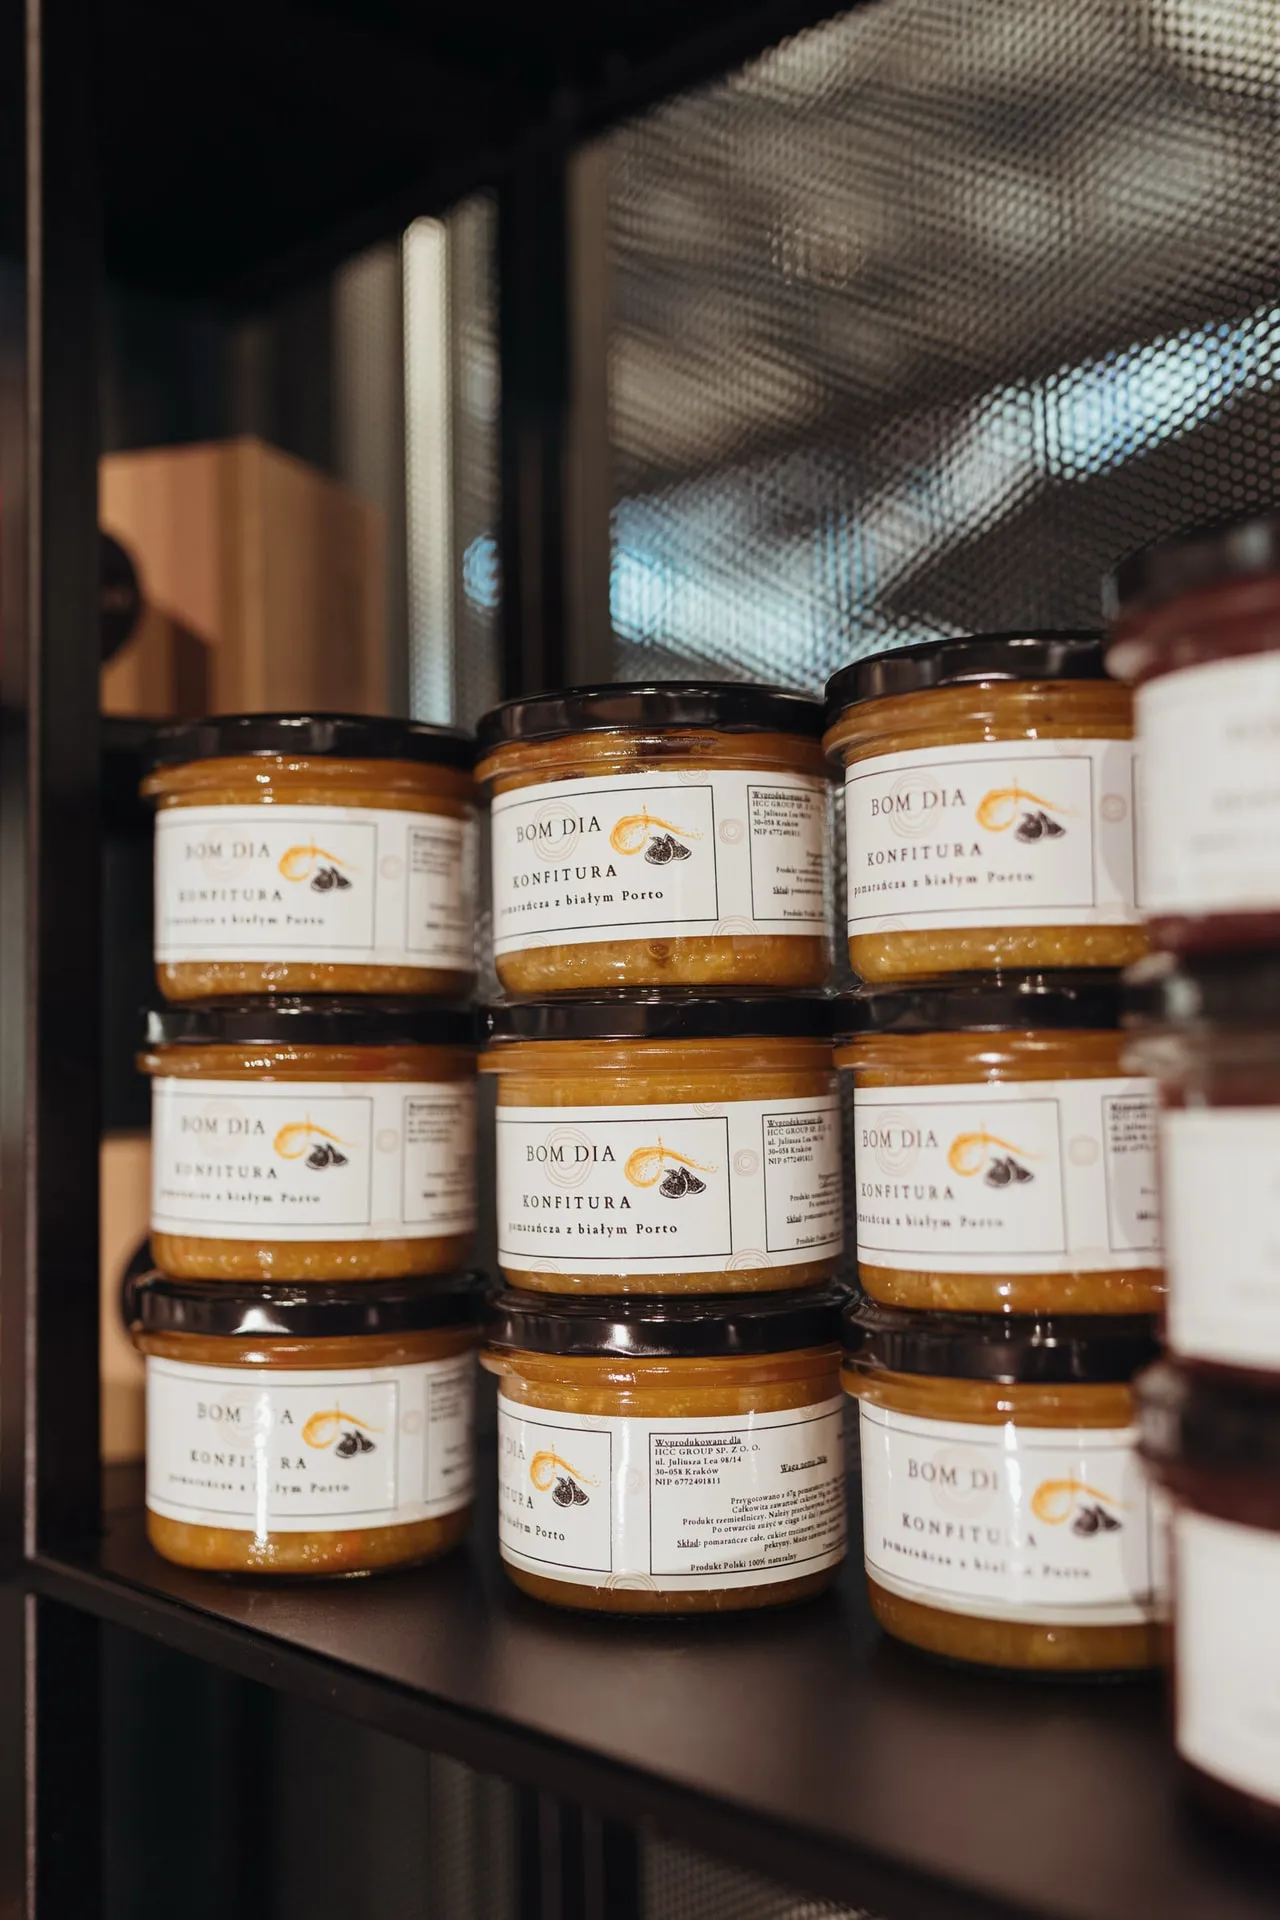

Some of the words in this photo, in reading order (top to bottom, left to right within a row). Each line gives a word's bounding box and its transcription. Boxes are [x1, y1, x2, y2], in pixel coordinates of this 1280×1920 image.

[872, 793, 911, 816] BOM
[922, 788, 966, 809] DIA
[517, 822, 553, 843] BOM
[562, 816, 602, 835] DIA
[233, 842, 270, 858] DIA
[867, 842, 983, 867] KONFITURA
[512, 864, 617, 889] KONFITURA
[555, 897, 561, 907] z
[566, 891, 614, 907] białym
[622, 889, 664, 902] Porto
[228, 1118, 265, 1135] DIA
[767, 1128, 784, 1137] HCC
[863, 1129, 892, 1148] BOM
[901, 1130, 938, 1148] DIA
[527, 1145, 564, 1162] BOM
[575, 1145, 616, 1162] DIA
[861, 1183, 955, 1200] KONFITURA
[523, 1195, 632, 1209] KONFITURA
[567, 1226, 572, 1234] z
[578, 1223, 627, 1238] białym
[636, 1223, 677, 1234] Porto
[197, 1402, 241, 1423] BOM
[655, 1438, 728, 1448] Wyprodukowane
[729, 1437, 742, 1445] dla
[655, 1448, 676, 1456] HCC
[679, 1447, 714, 1456] GROUP
[716, 1446, 728, 1455] SP.
[655, 1458, 665, 1466] ul.
[668, 1458, 701, 1468] Juliusza
[685, 1467, 719, 1475] Kraków
[655, 1478, 672, 1486] NIP
[908, 1458, 958, 1486] BOM
[971, 1471, 1004, 1491] DI
[732, 1505, 768, 1513] Całkowita
[683, 1517, 714, 1525] Produkt
[724, 1523, 755, 1532] otwarciu
[902, 1512, 1037, 1547] KONFITUA
[535, 1525, 565, 1541] Porto
[677, 1538, 701, 1548] Skład:
[703, 1536, 748, 1548] pomarańcze
[767, 1530, 787, 1540] cukier
[690, 1563, 722, 1571] Produkt
[724, 1560, 746, 1570] Polski
[749, 1558, 766, 1567] 100%
[768, 1552, 798, 1564] naturalny
